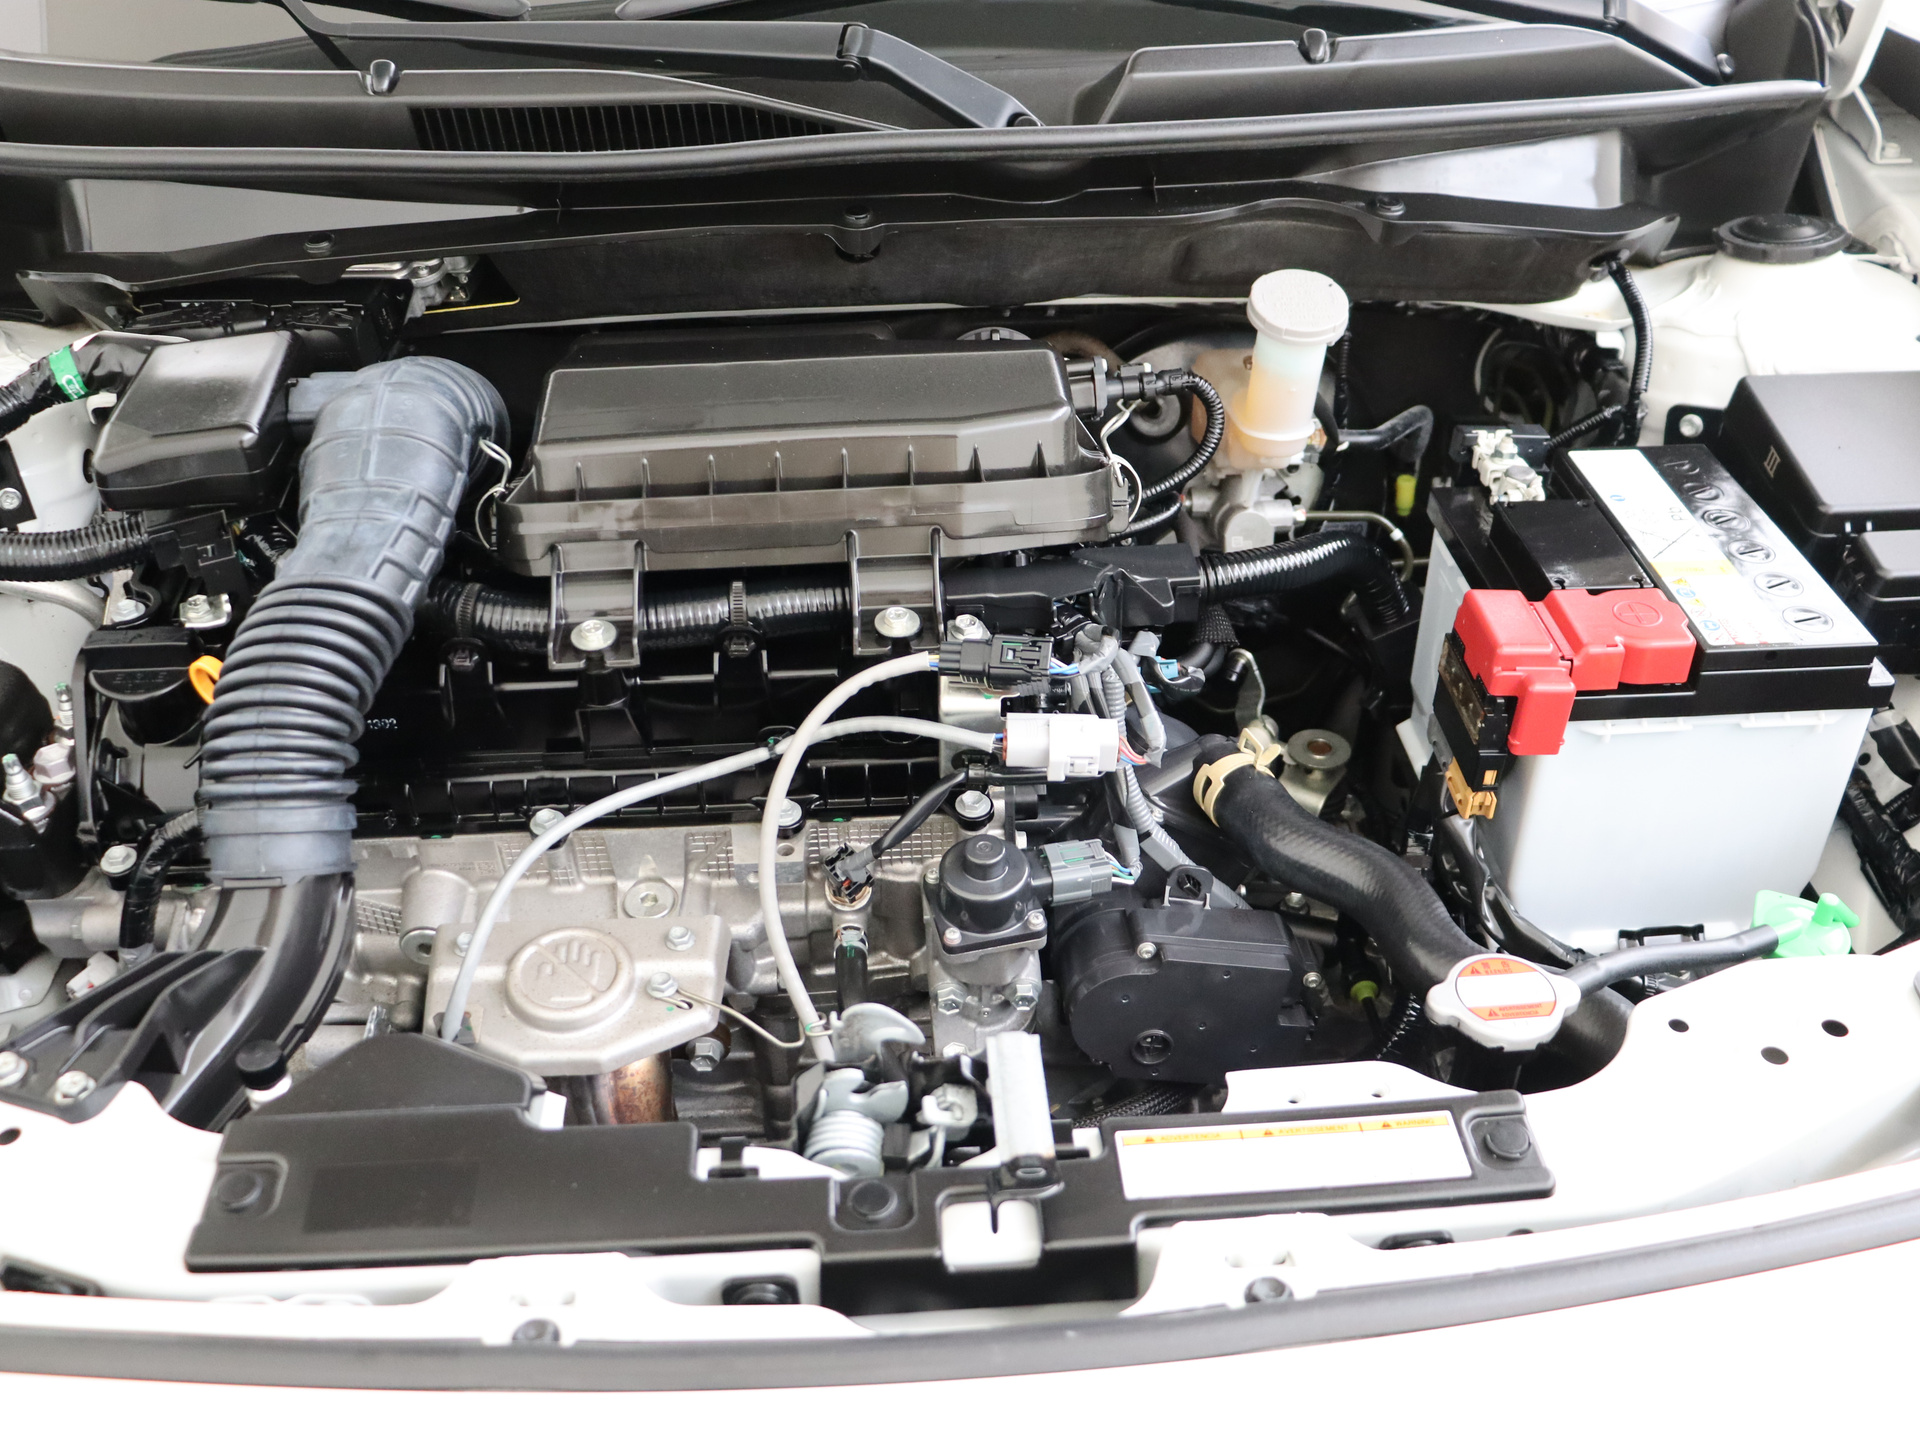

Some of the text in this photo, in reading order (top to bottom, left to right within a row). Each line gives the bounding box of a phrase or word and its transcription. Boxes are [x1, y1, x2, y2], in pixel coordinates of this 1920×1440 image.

[1395, 1117, 1434, 1127] WARNING
[1278, 1124, 1349, 1134] AVERTISSEMENT
[1160, 1133, 1221, 1141] ADVERTENCIA
